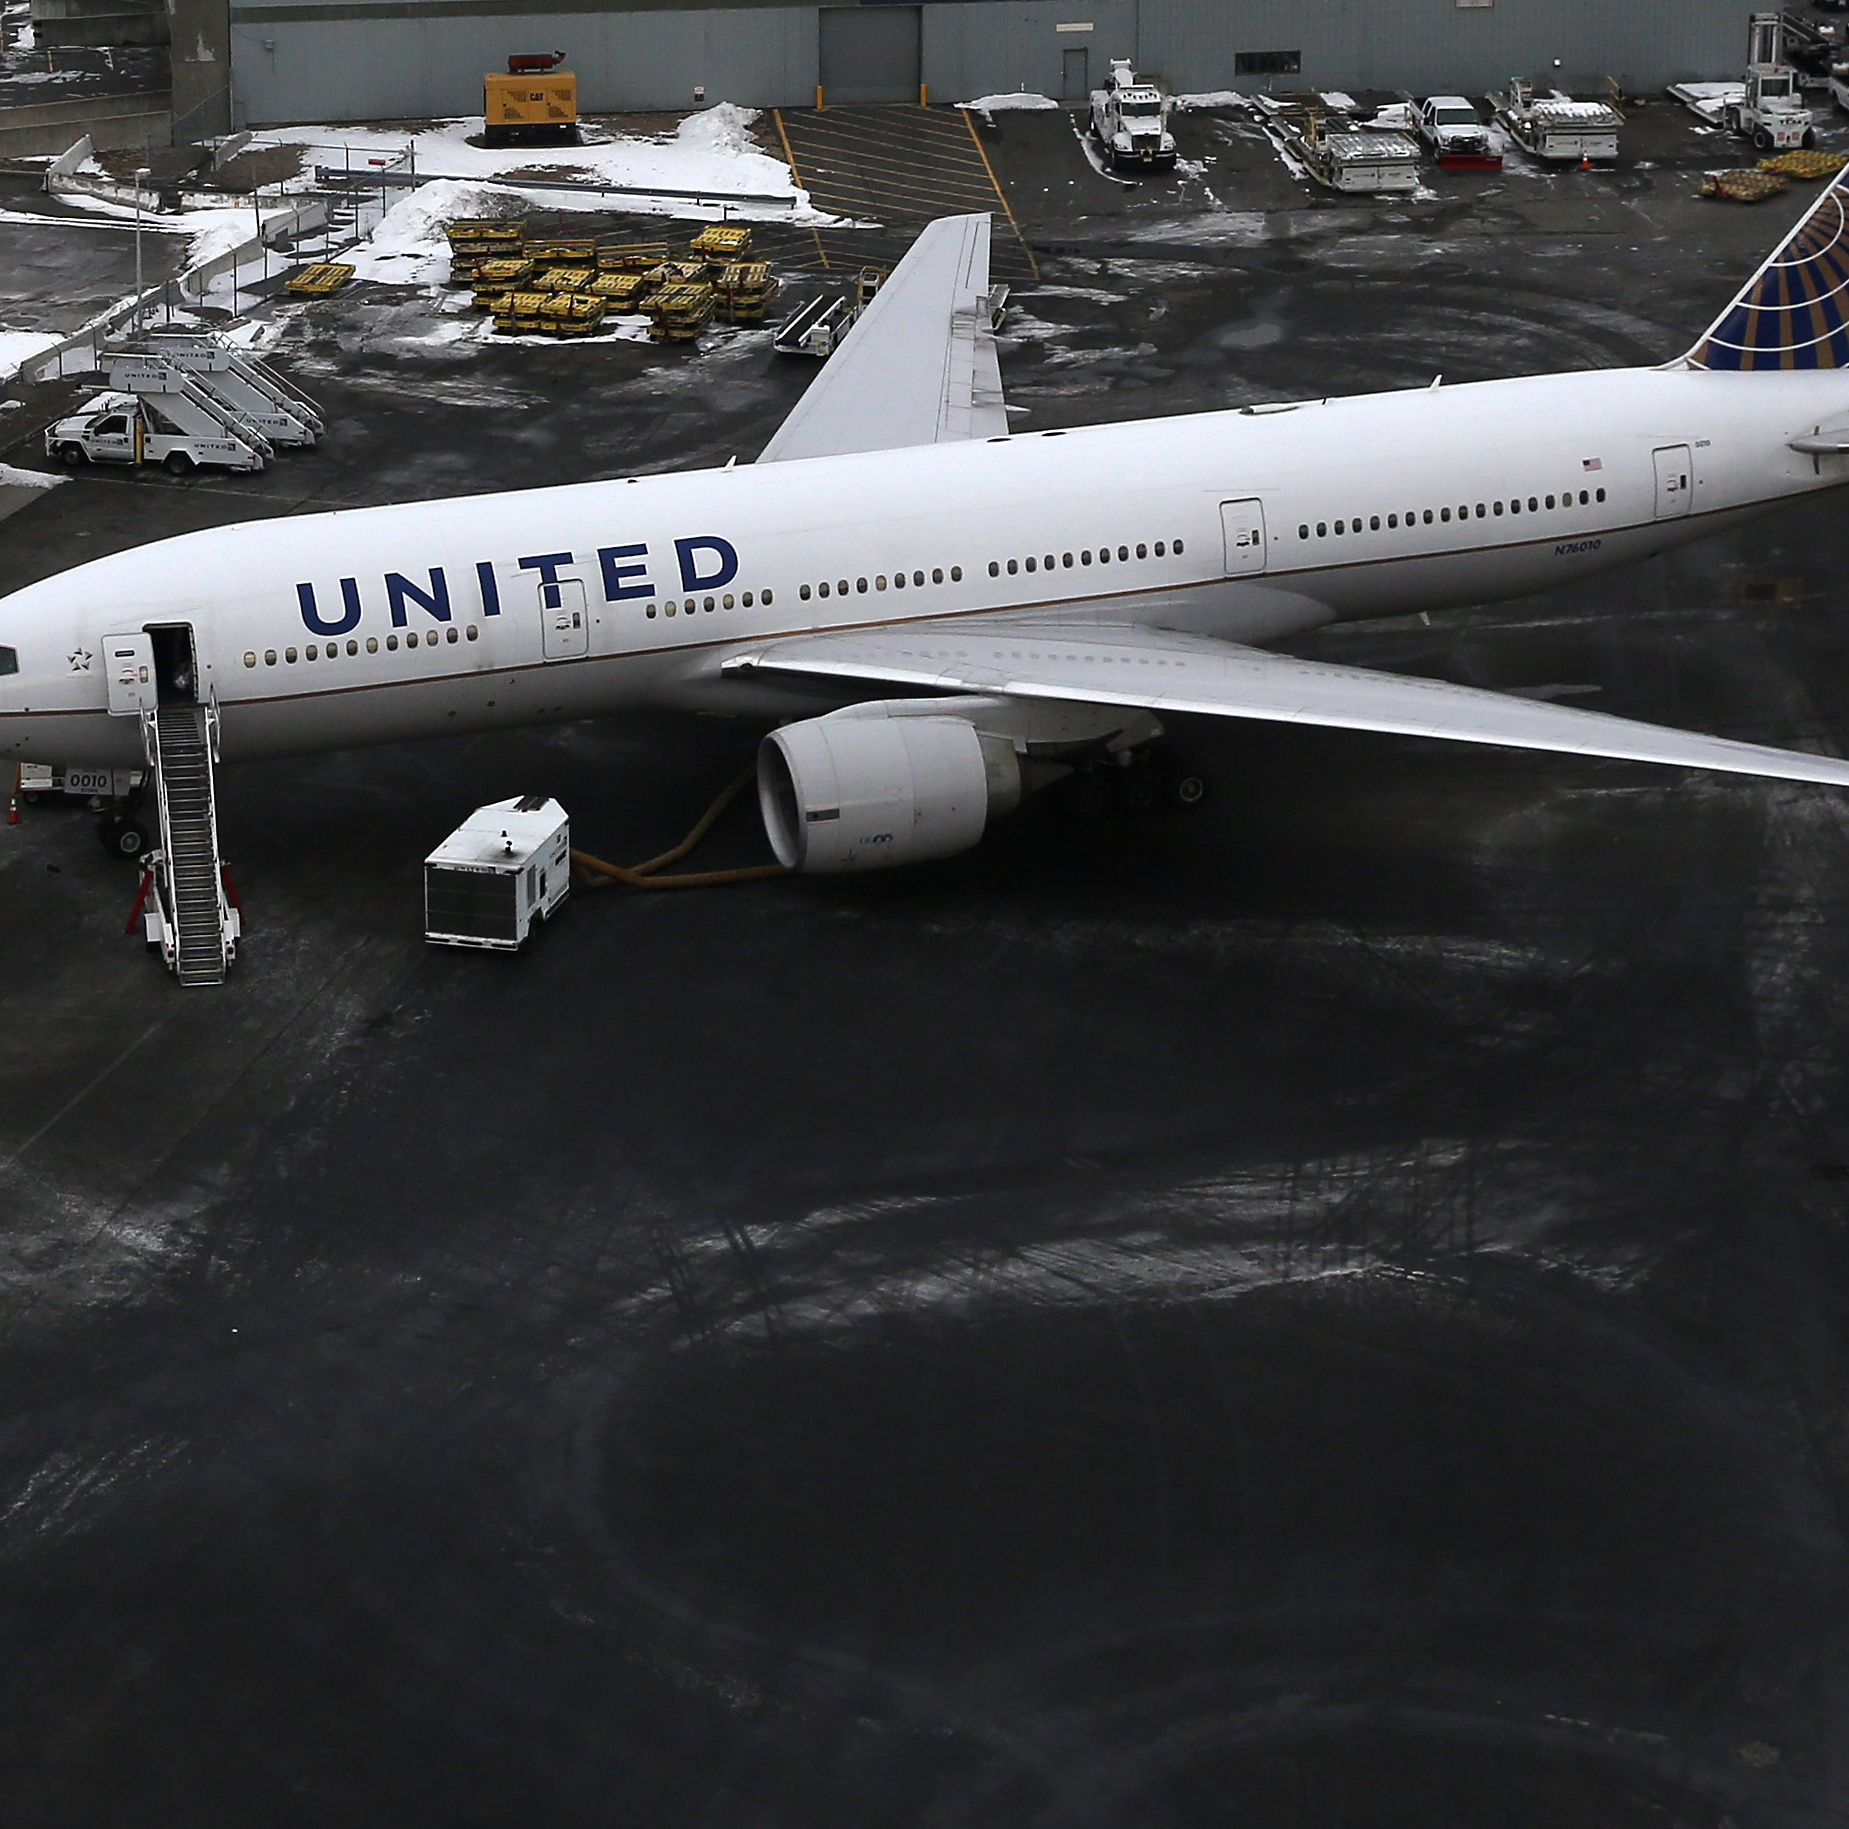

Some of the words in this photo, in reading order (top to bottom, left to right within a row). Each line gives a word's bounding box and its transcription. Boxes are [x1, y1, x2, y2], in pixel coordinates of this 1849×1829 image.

[529, 92, 544, 101] CAT
[1554, 539, 1601, 556] N76010
[296, 535, 741, 636] UNITED
[70, 774, 107, 788] 0010
